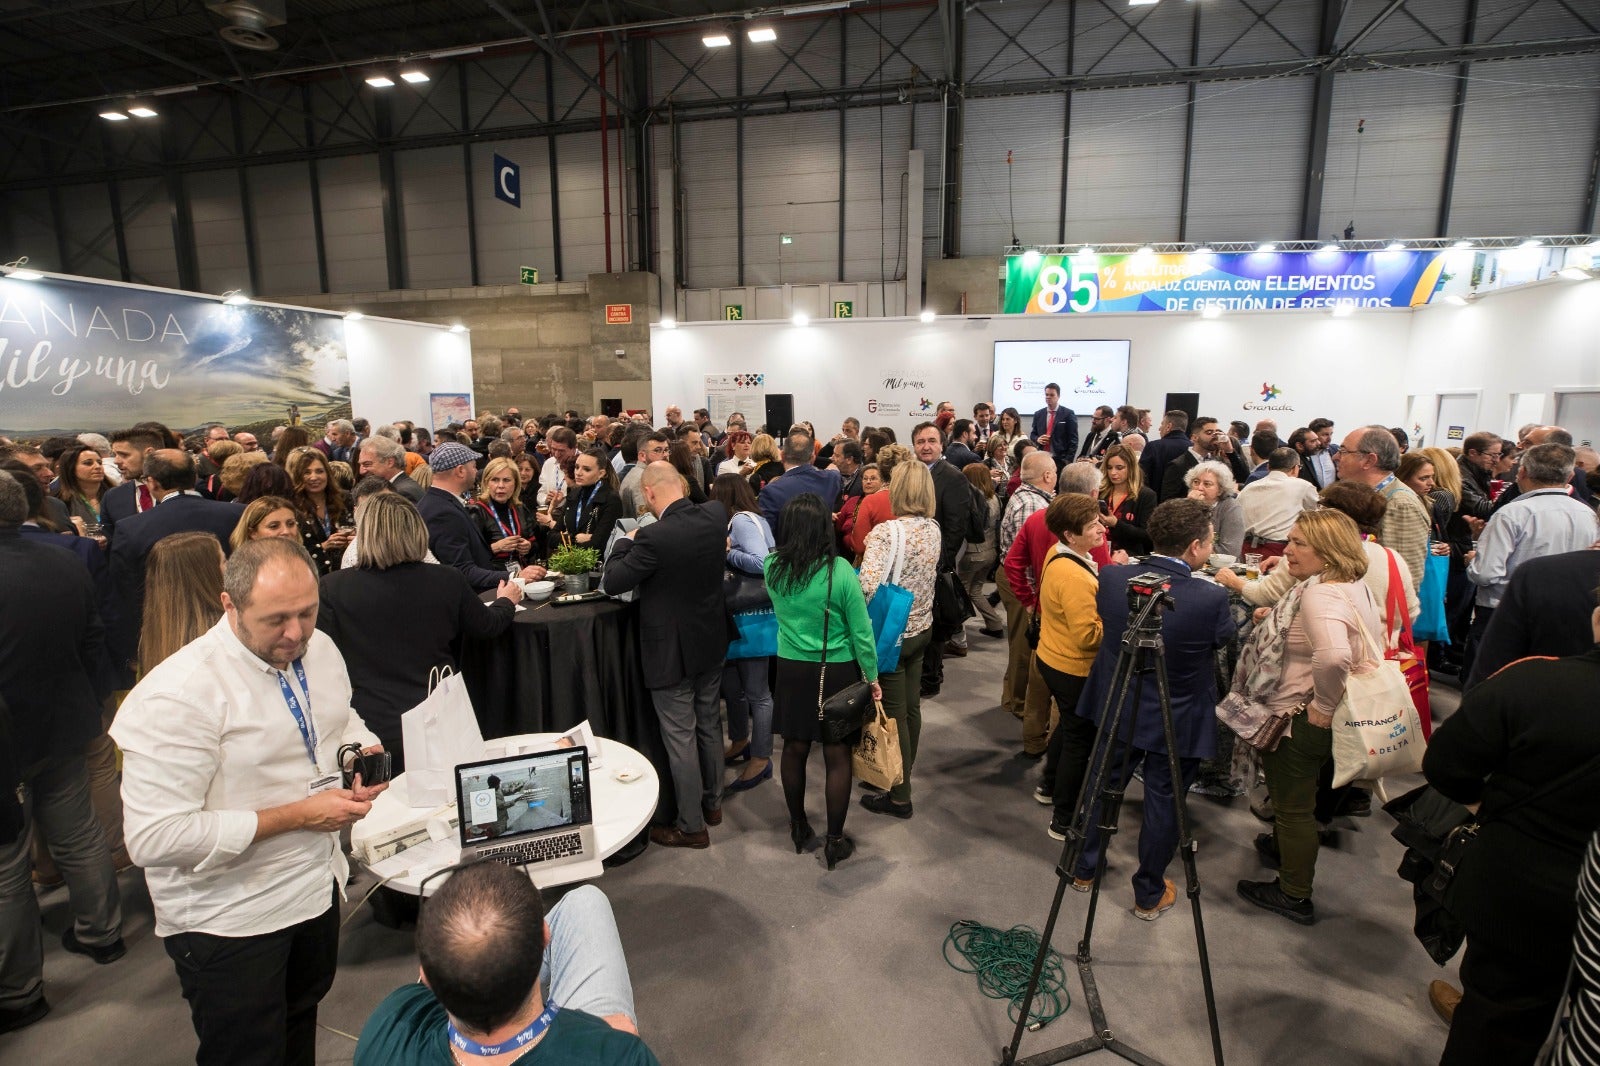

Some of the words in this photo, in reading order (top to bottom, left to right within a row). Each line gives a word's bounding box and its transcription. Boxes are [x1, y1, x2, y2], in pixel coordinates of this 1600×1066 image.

[501, 166, 515, 199] C
[1123, 280, 1181, 292] ANDALUZ
[1183, 280, 1231, 291] CUENTA
[1234, 279, 1260, 291] CON
[1265, 275, 1376, 291] ELEMENTOS
[1166, 297, 1190, 311] DE
[1193, 294, 1267, 311] GESTIÓN
[1242, 402, 1295, 412] Granada
[1389, 726, 1407, 738] KLM
[1379, 739, 1409, 755] DELTA
